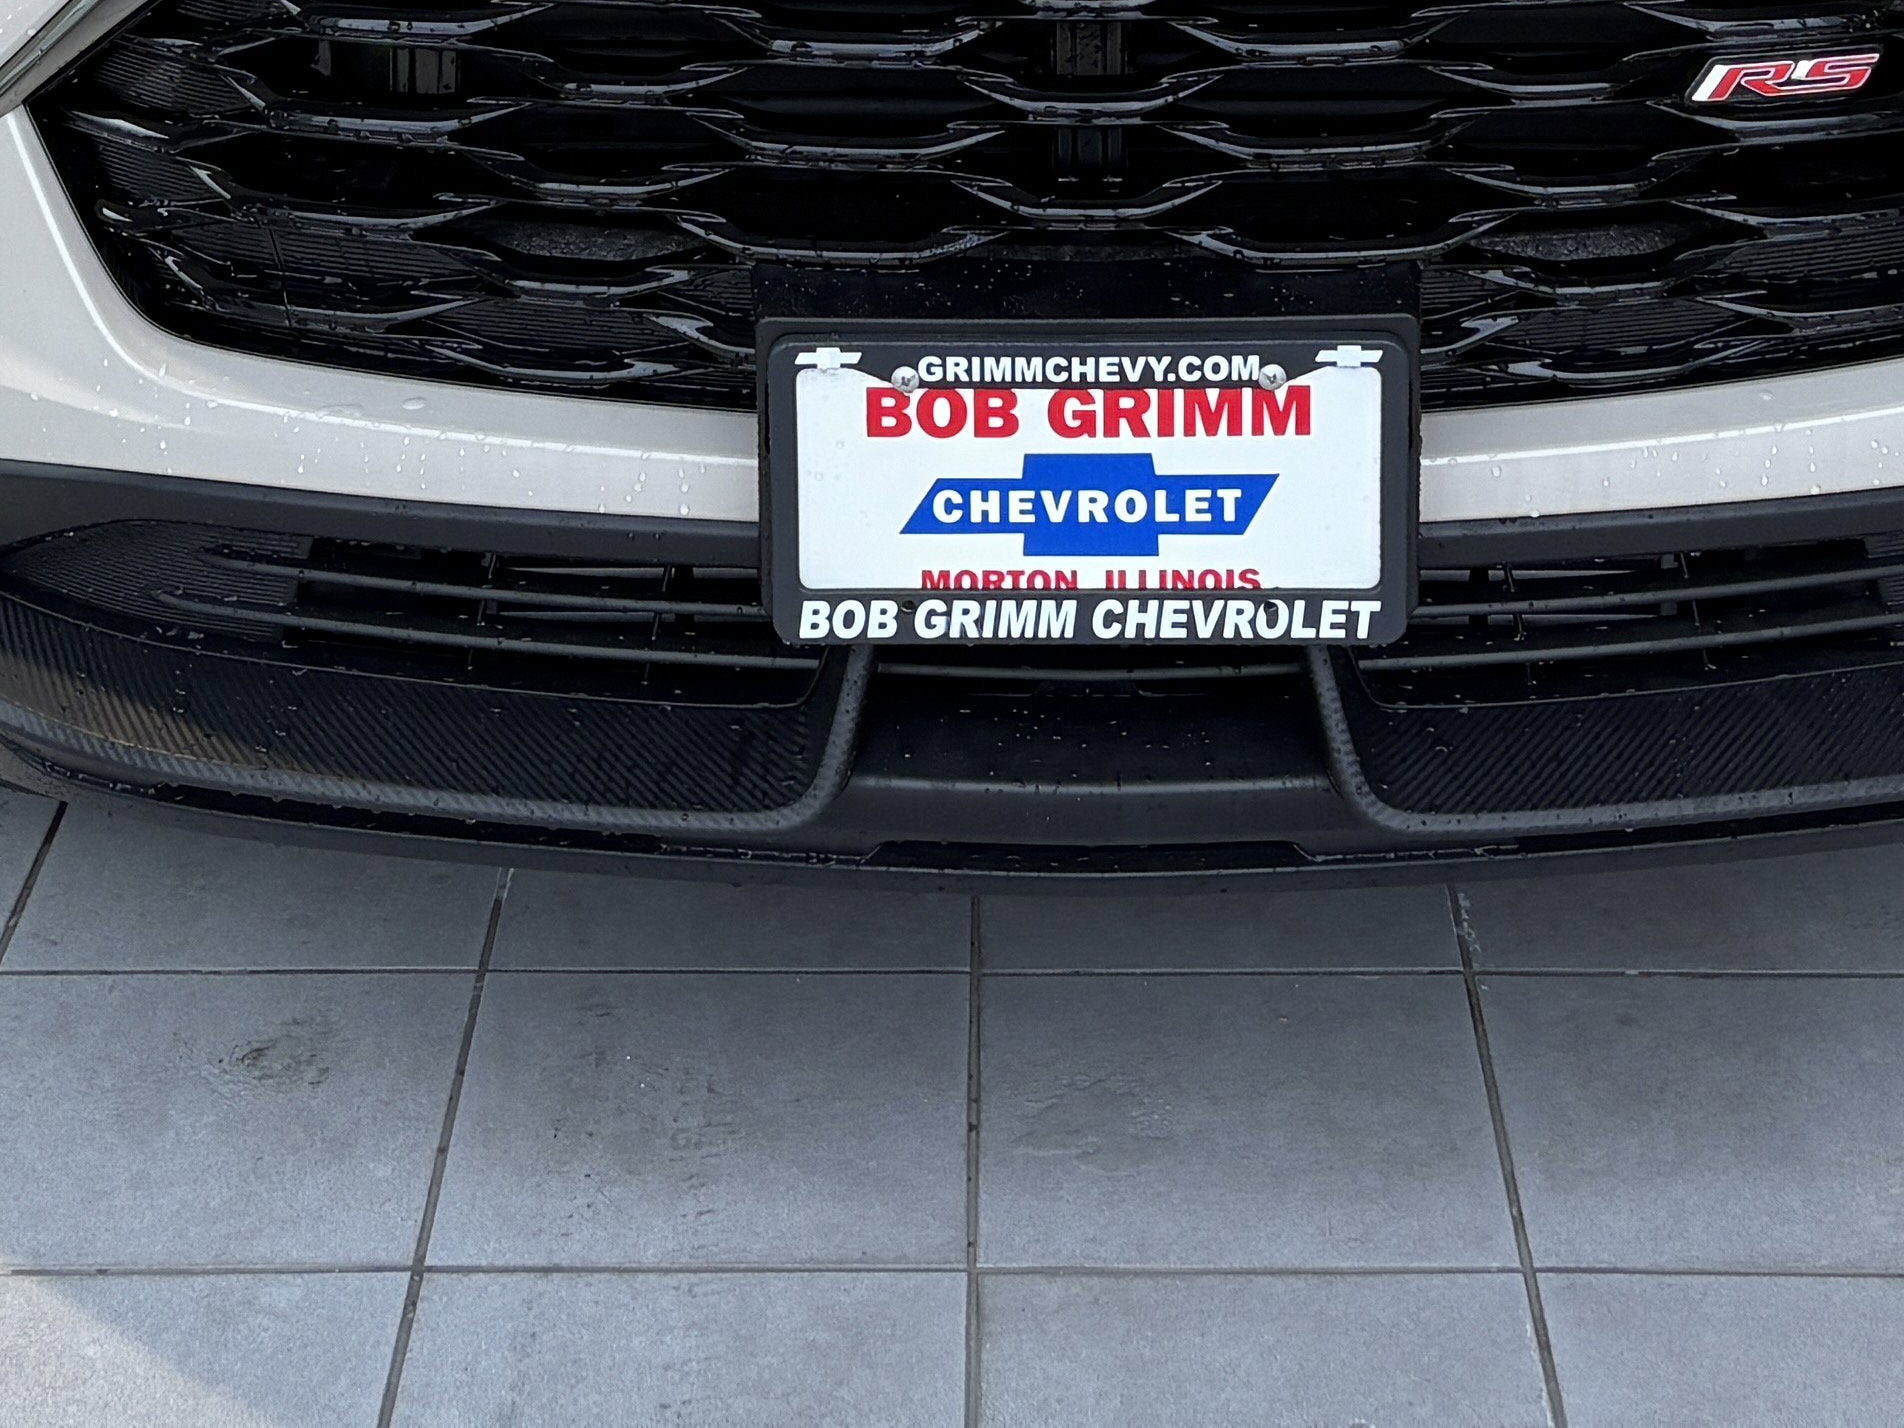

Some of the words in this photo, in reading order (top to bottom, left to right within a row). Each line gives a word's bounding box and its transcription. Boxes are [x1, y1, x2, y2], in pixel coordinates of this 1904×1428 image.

[1691, 52, 1880, 102] RS
[916, 354, 1261, 383] GRIMMCHEVY.COM
[865, 386, 1019, 439] BOB
[1047, 384, 1312, 438] GRIMM
[932, 488, 1244, 524] CHEVROLET
[921, 569, 1079, 590] MORTON
[798, 599, 898, 639] BOB
[914, 599, 1076, 639] GRIMM
[1091, 598, 1382, 640] CHEVROLET
